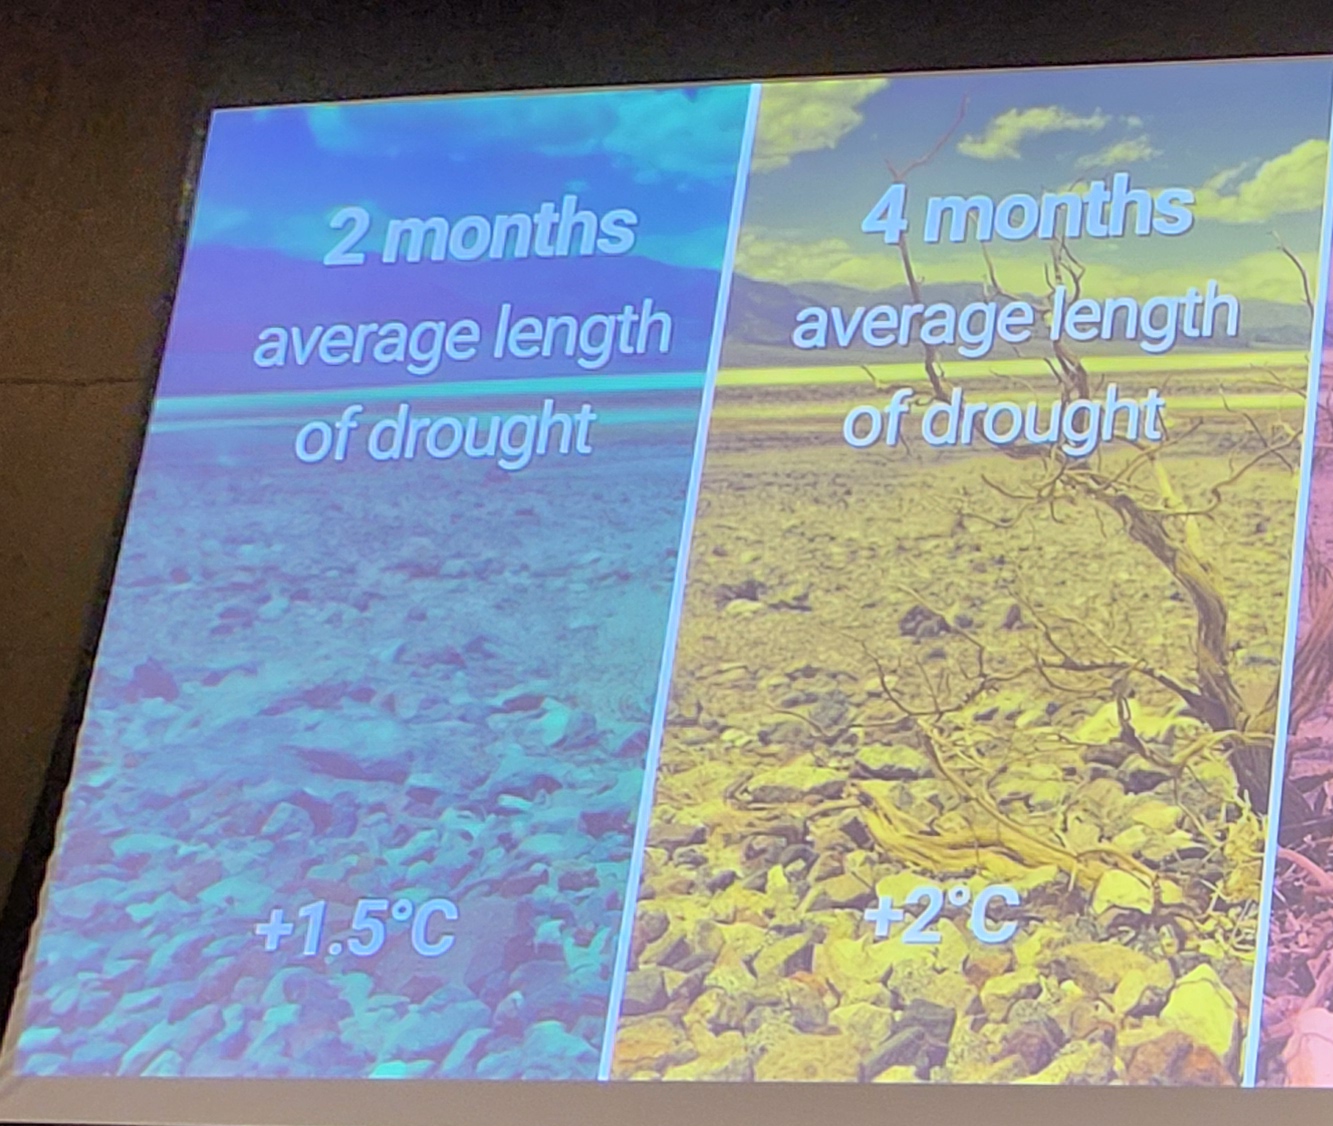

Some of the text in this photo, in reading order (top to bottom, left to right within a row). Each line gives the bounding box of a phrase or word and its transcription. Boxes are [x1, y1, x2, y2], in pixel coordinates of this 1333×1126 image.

[323, 194, 639, 266] 2 months
[861, 172, 1194, 244] 4 months
[252, 298, 673, 376] average length
[792, 280, 1241, 359] average length
[294, 399, 597, 470] of drought
[843, 383, 1165, 458] of drought
[254, 897, 461, 958] +1.5°C
[863, 885, 1022, 945] +2°C
